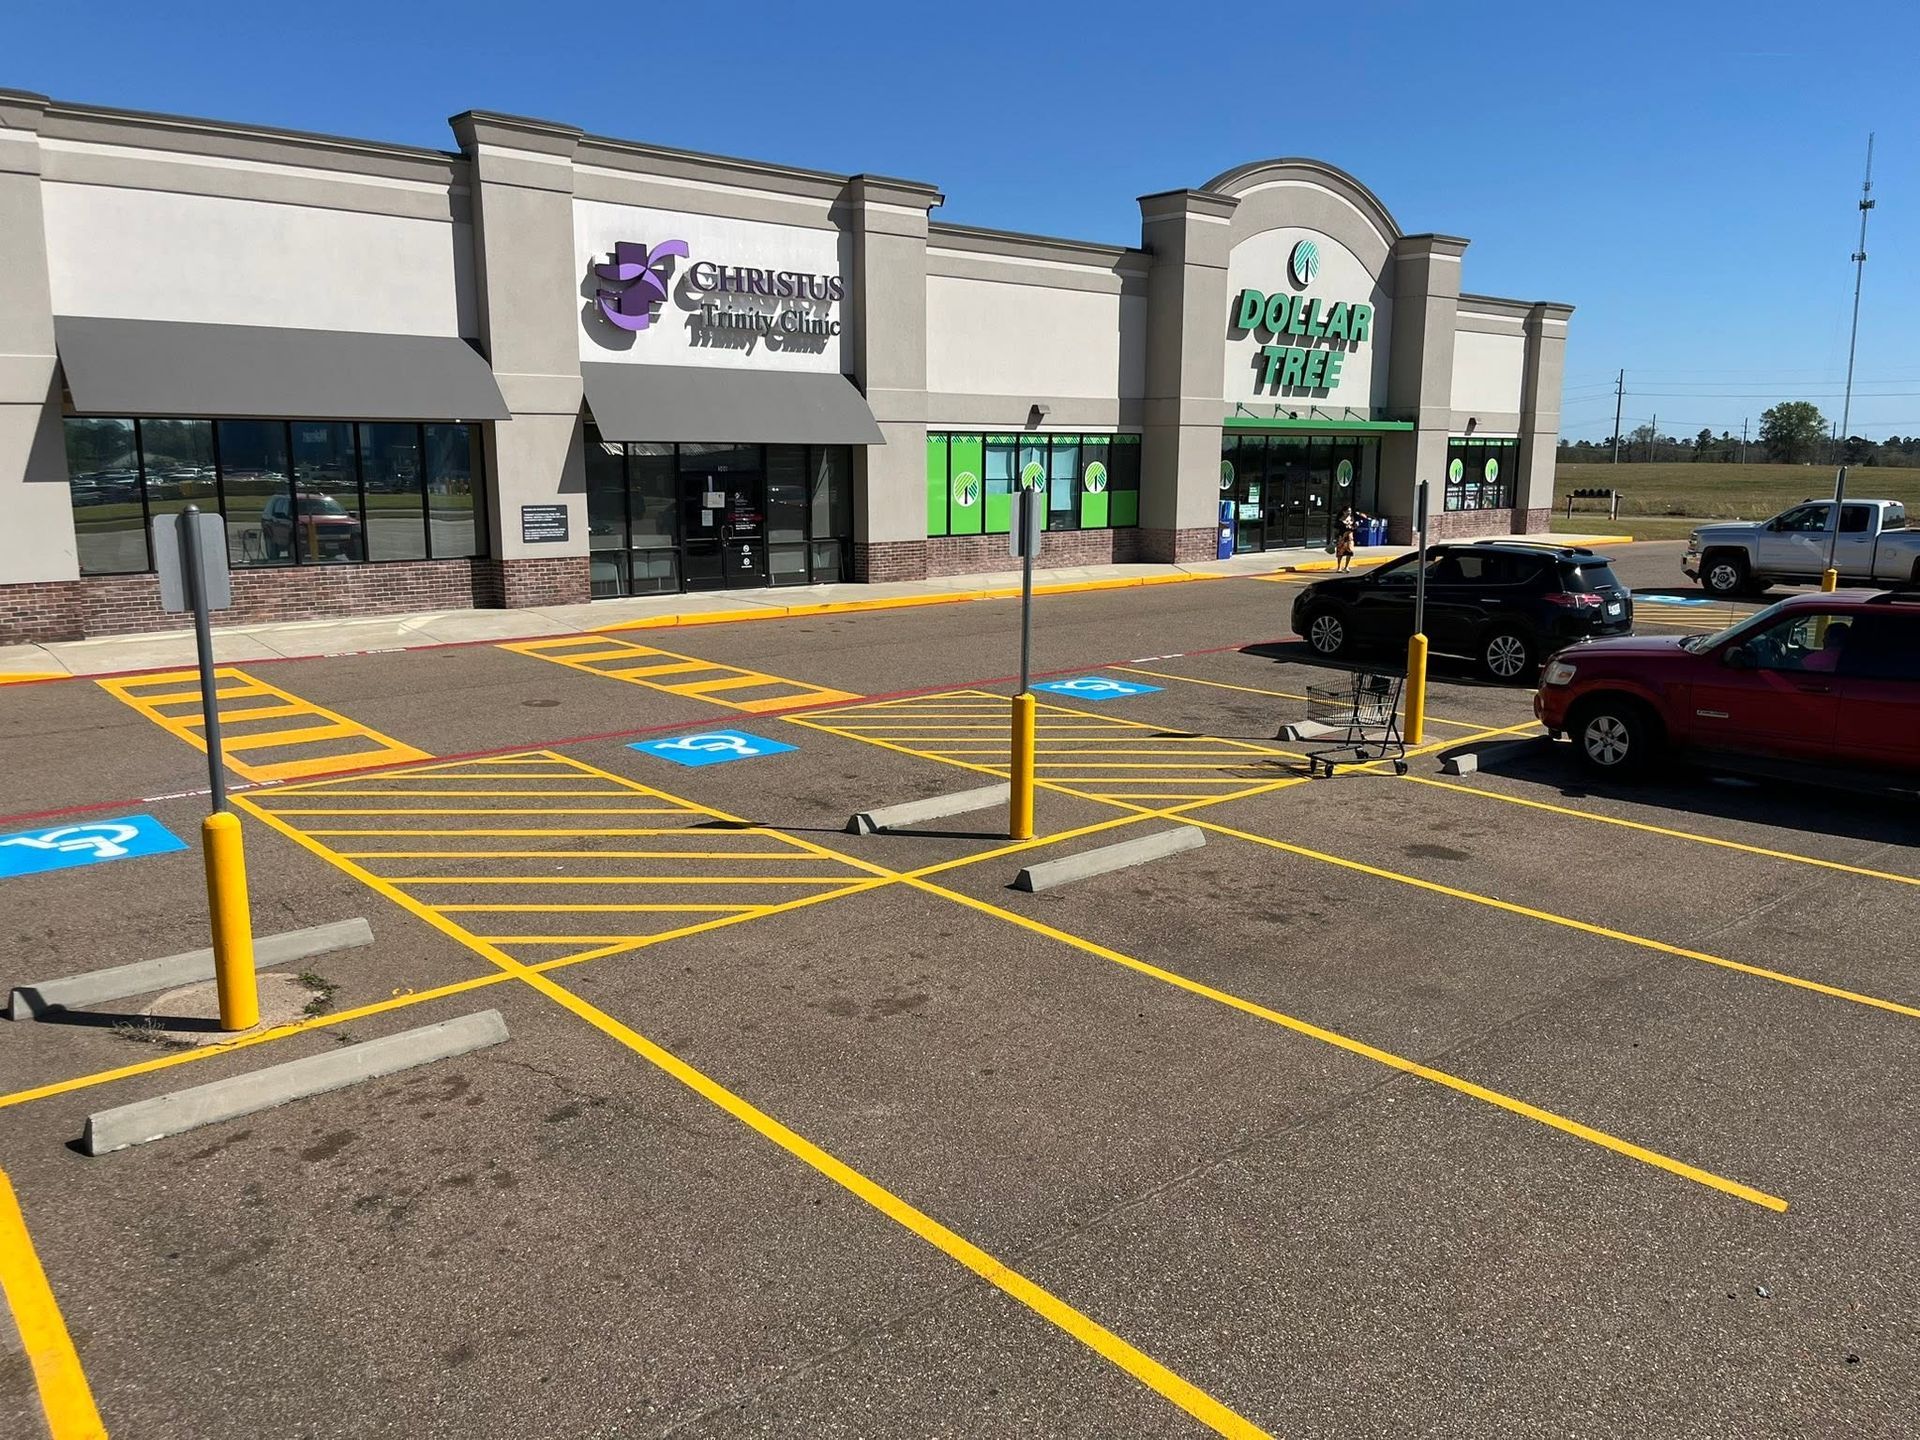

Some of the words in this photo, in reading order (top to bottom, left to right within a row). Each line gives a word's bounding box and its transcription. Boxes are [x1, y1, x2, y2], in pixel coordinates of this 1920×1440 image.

[689, 261, 845, 301] CHRISTUS
[702, 303, 774, 337] Trinity
[780, 309, 841, 336] Clinic
[1238, 289, 1372, 342] DOLLAR
[1262, 345, 1345, 389] TREE
